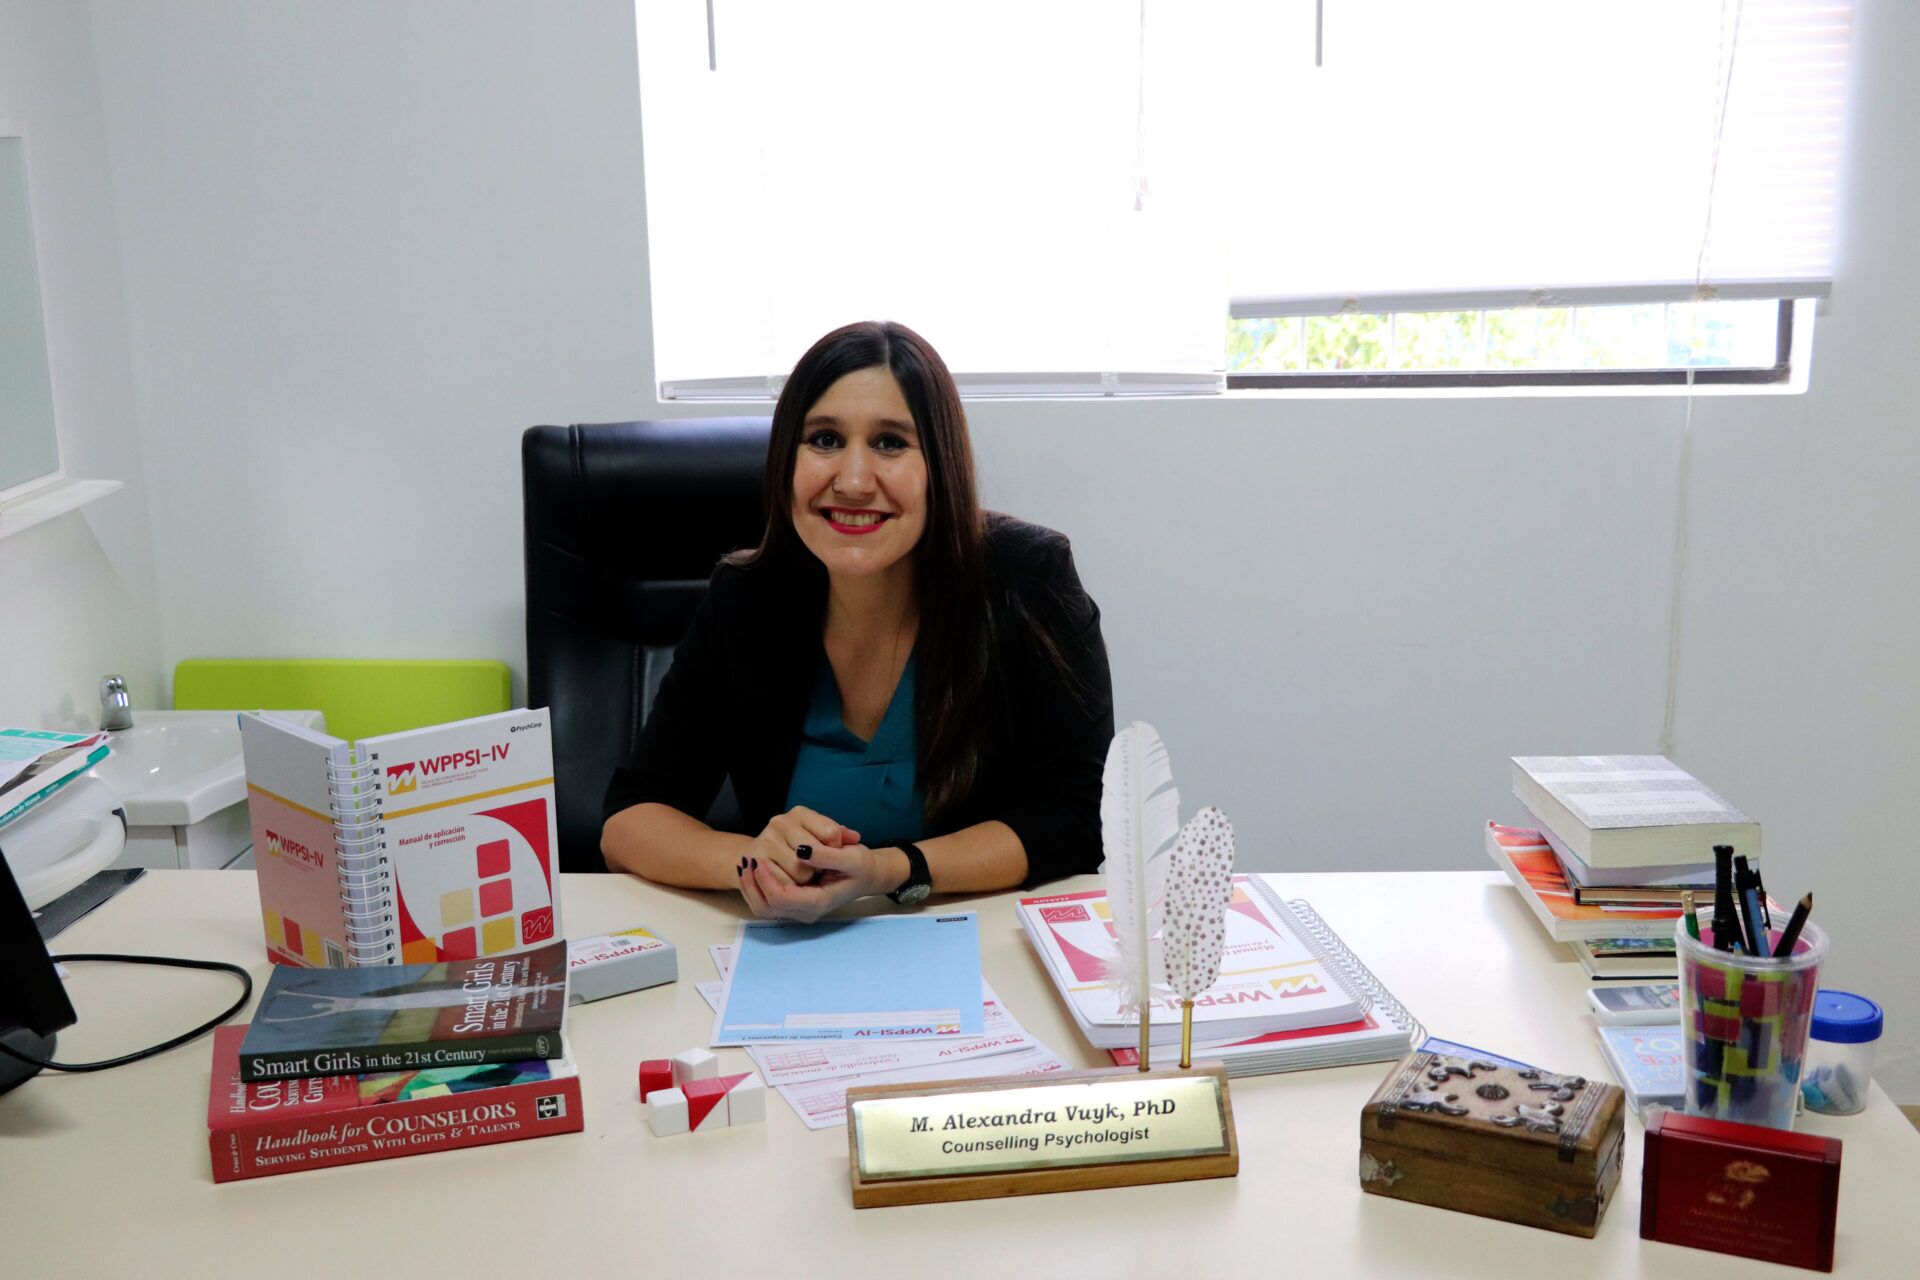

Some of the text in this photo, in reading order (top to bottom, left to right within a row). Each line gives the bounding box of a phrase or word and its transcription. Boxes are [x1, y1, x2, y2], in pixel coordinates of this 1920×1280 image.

[517, 723, 542, 731] PsychCorp
[419, 742, 510, 775] WPPSI-IV
[399, 825, 465, 847] Manual de aplicación
[429, 834, 465, 849] y corrección
[280, 835, 324, 868] WPPSI-IV
[571, 945, 648, 967] WPPSI-IV
[1233, 945, 1275, 956] Manual
[495, 960, 520, 990] Century
[453, 962, 495, 1032] Smart Girls
[492, 991, 511, 1007] 21st
[487, 1020, 506, 1029] in
[490, 1008, 508, 1021] the
[854, 1027, 933, 1036] WPPSI-IV
[939, 1040, 1002, 1057] WPPSI-IV
[253, 1058, 309, 1076] Smart
[314, 1052, 361, 1071] Girls
[366, 1055, 378, 1067] in
[382, 1054, 401, 1066] the
[405, 1052, 432, 1064] 21st
[434, 1049, 486, 1062] Century
[256, 1101, 517, 1151] Handbook for COUNSELORS
[910, 1099, 1176, 1132] M. Alexandra Vuyk, PhD
[255, 1121, 521, 1167] SERVING STUDENTS WITH GIFTS & TALENTS
[942, 1127, 1150, 1154] Counselling Psychologist
